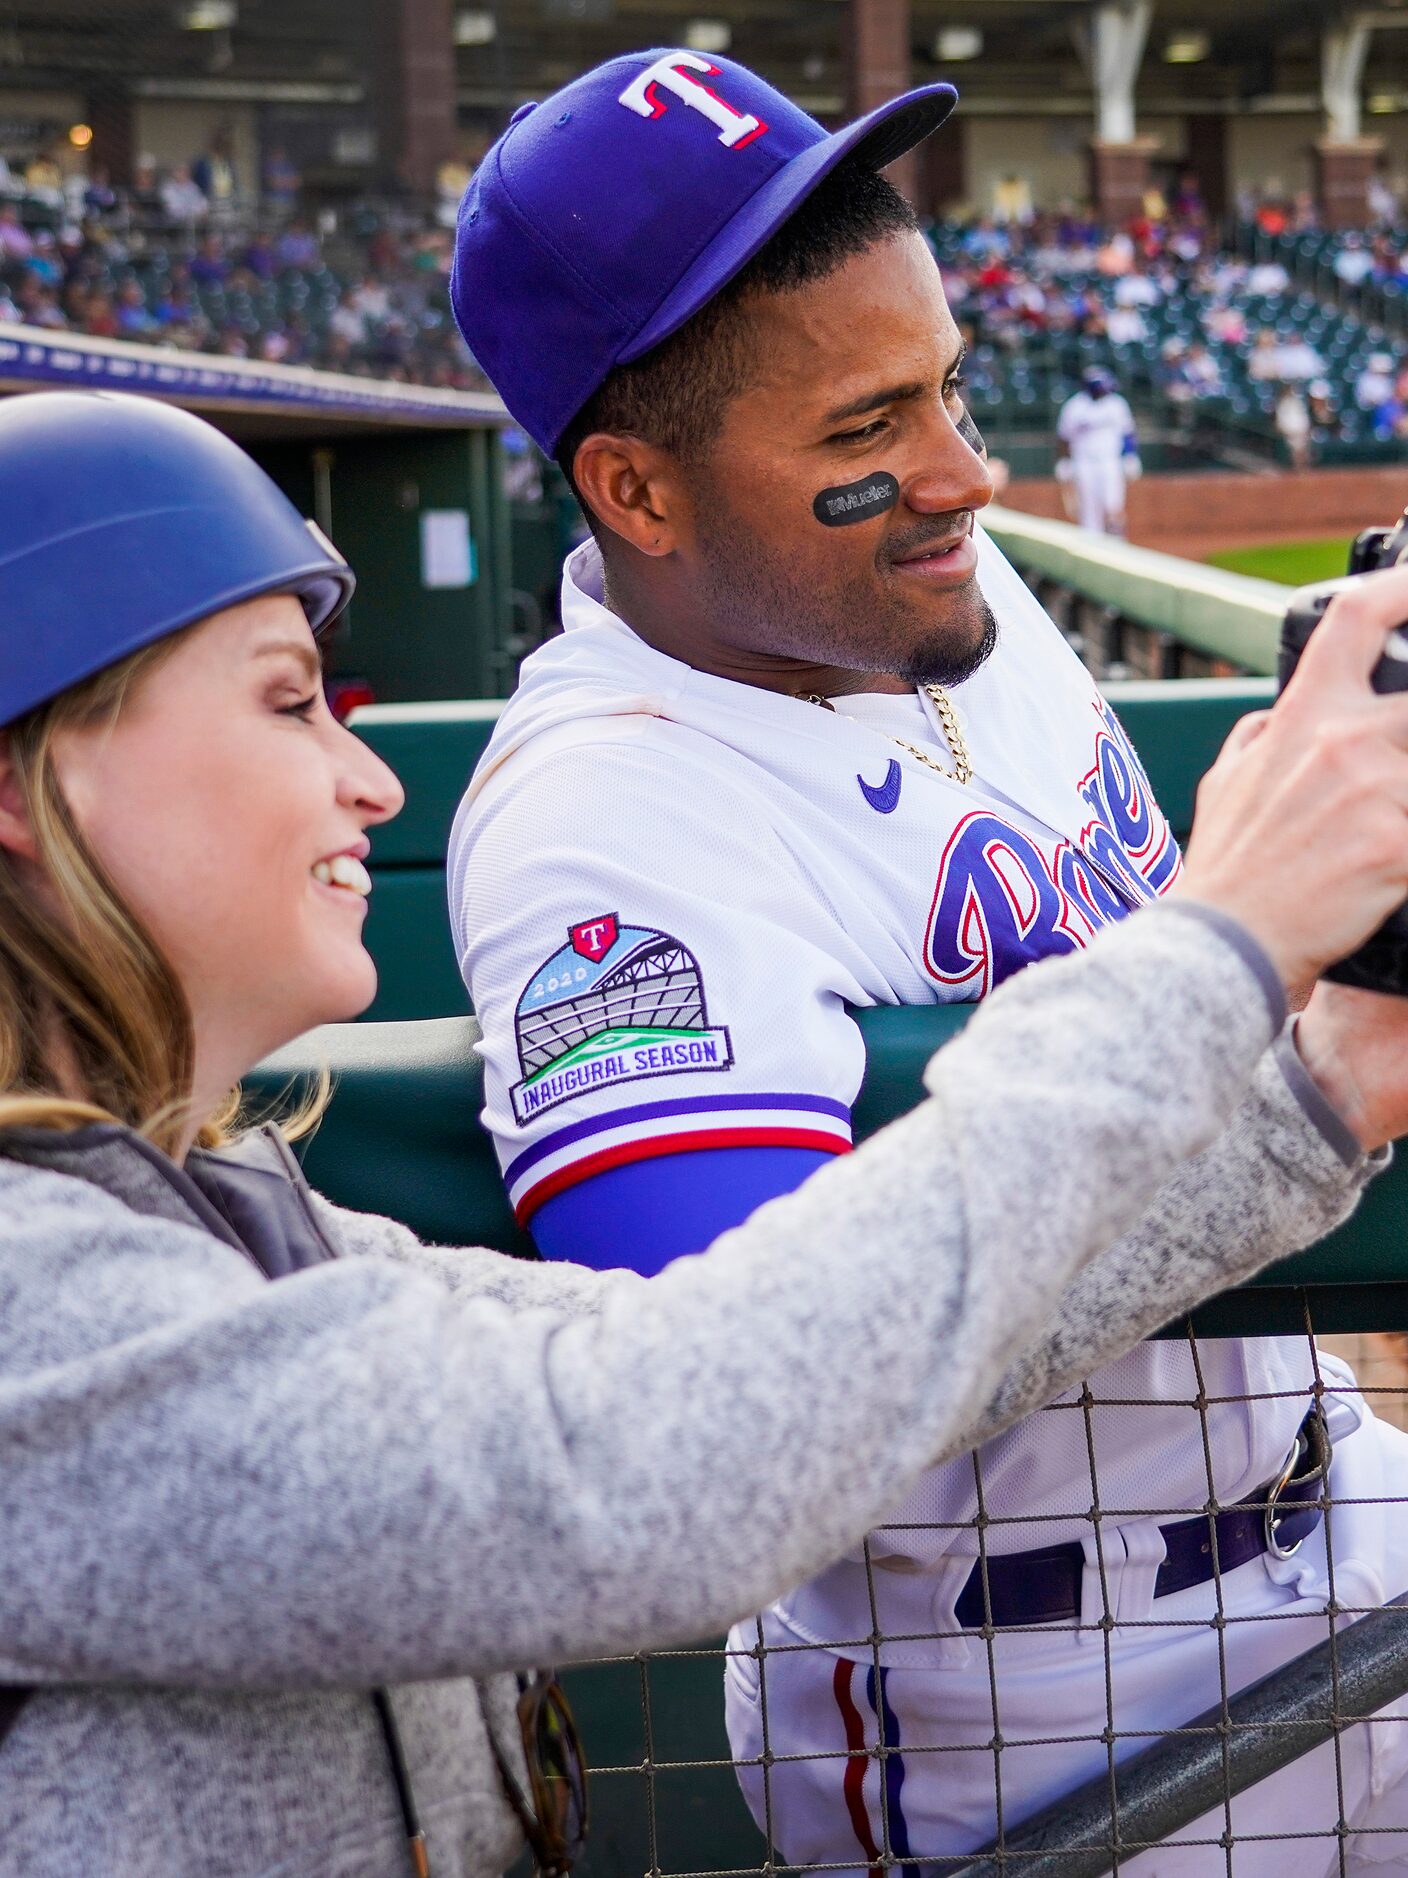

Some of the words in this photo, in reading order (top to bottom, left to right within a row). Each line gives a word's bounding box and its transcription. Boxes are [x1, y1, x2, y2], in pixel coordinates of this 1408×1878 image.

[619, 52, 769, 150] T
[831, 484, 891, 514] Mueller
[580, 922, 609, 953] T
[534, 967, 588, 999] 2020
[523, 1056, 632, 1114] INAUGURAL
[635, 1040, 718, 1071] SEASON
